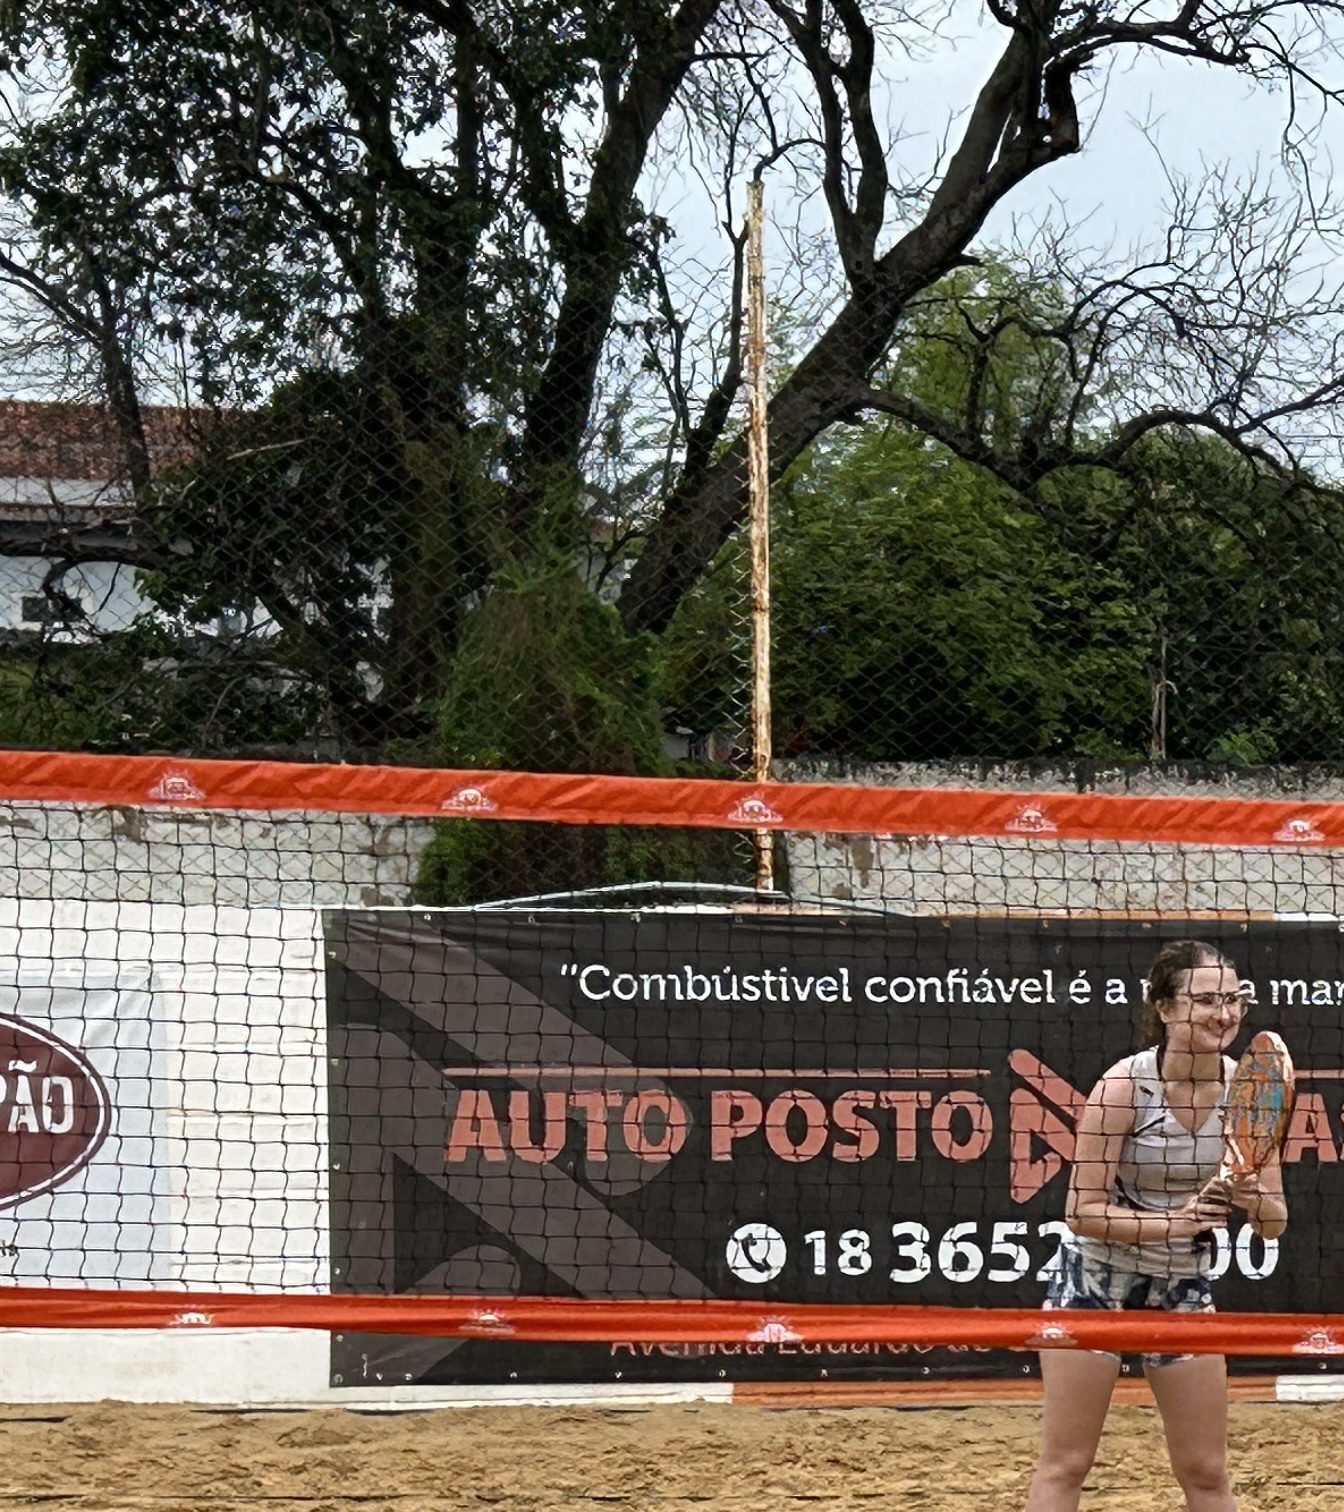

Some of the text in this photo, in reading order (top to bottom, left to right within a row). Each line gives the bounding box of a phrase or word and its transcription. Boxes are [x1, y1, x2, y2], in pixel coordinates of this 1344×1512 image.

[864, 967, 1056, 1004] confiável
[1069, 969, 1092, 1004] é
[1104, 977, 1128, 1004] a
[443, 1089, 691, 1164] AUTO
[711, 1089, 993, 1164] POSTO
[804, 1229, 872, 1276] 18
